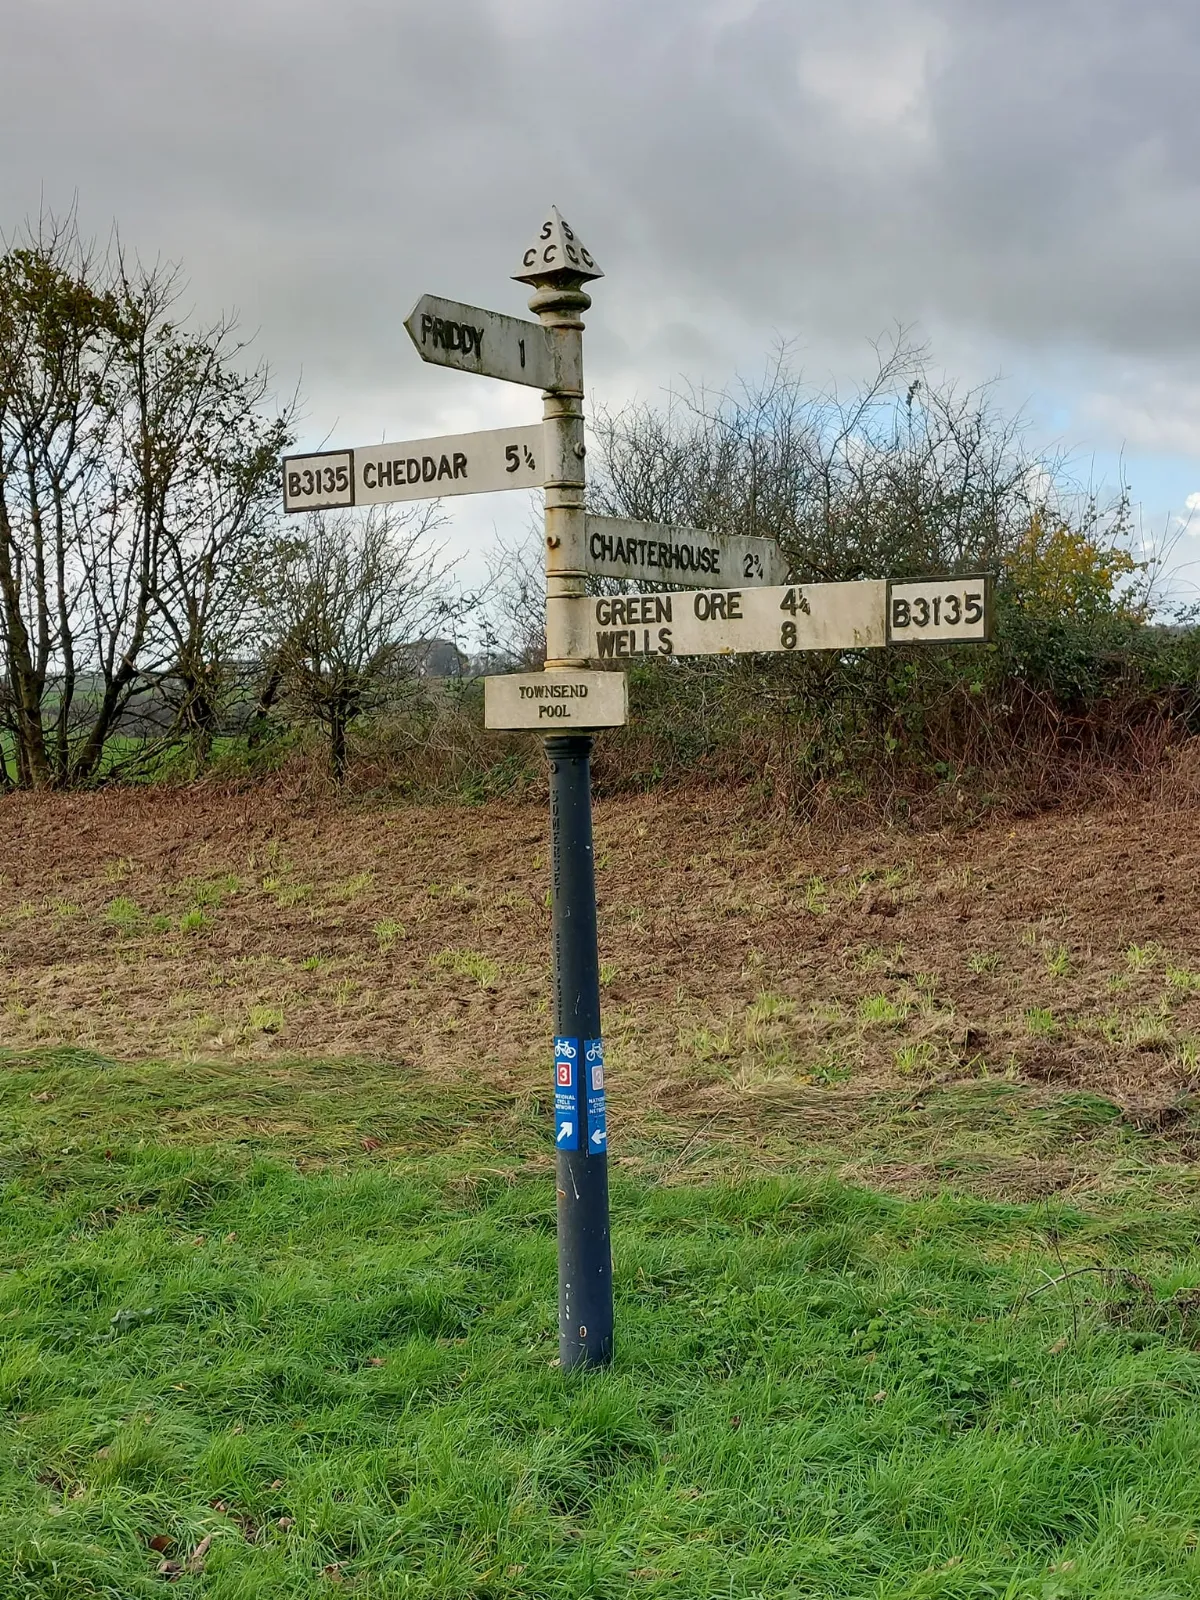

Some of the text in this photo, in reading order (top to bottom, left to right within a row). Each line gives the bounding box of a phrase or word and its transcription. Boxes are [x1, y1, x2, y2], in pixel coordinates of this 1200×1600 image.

[421, 313, 525, 368] PRIDDY 1
[288, 466, 349, 497] B3135
[363, 452, 468, 489] CHEDDAR
[589, 532, 721, 574] CHARTERHOUSE
[595, 595, 673, 626] GREEN
[693, 591, 743, 621] ORE
[893, 592, 983, 628] B3135
[596, 620, 798, 658] WELLS 8
[519, 684, 589, 699] TOWNSEND
[538, 704, 571, 718] POOL
[559, 1067, 568, 1082] 3
